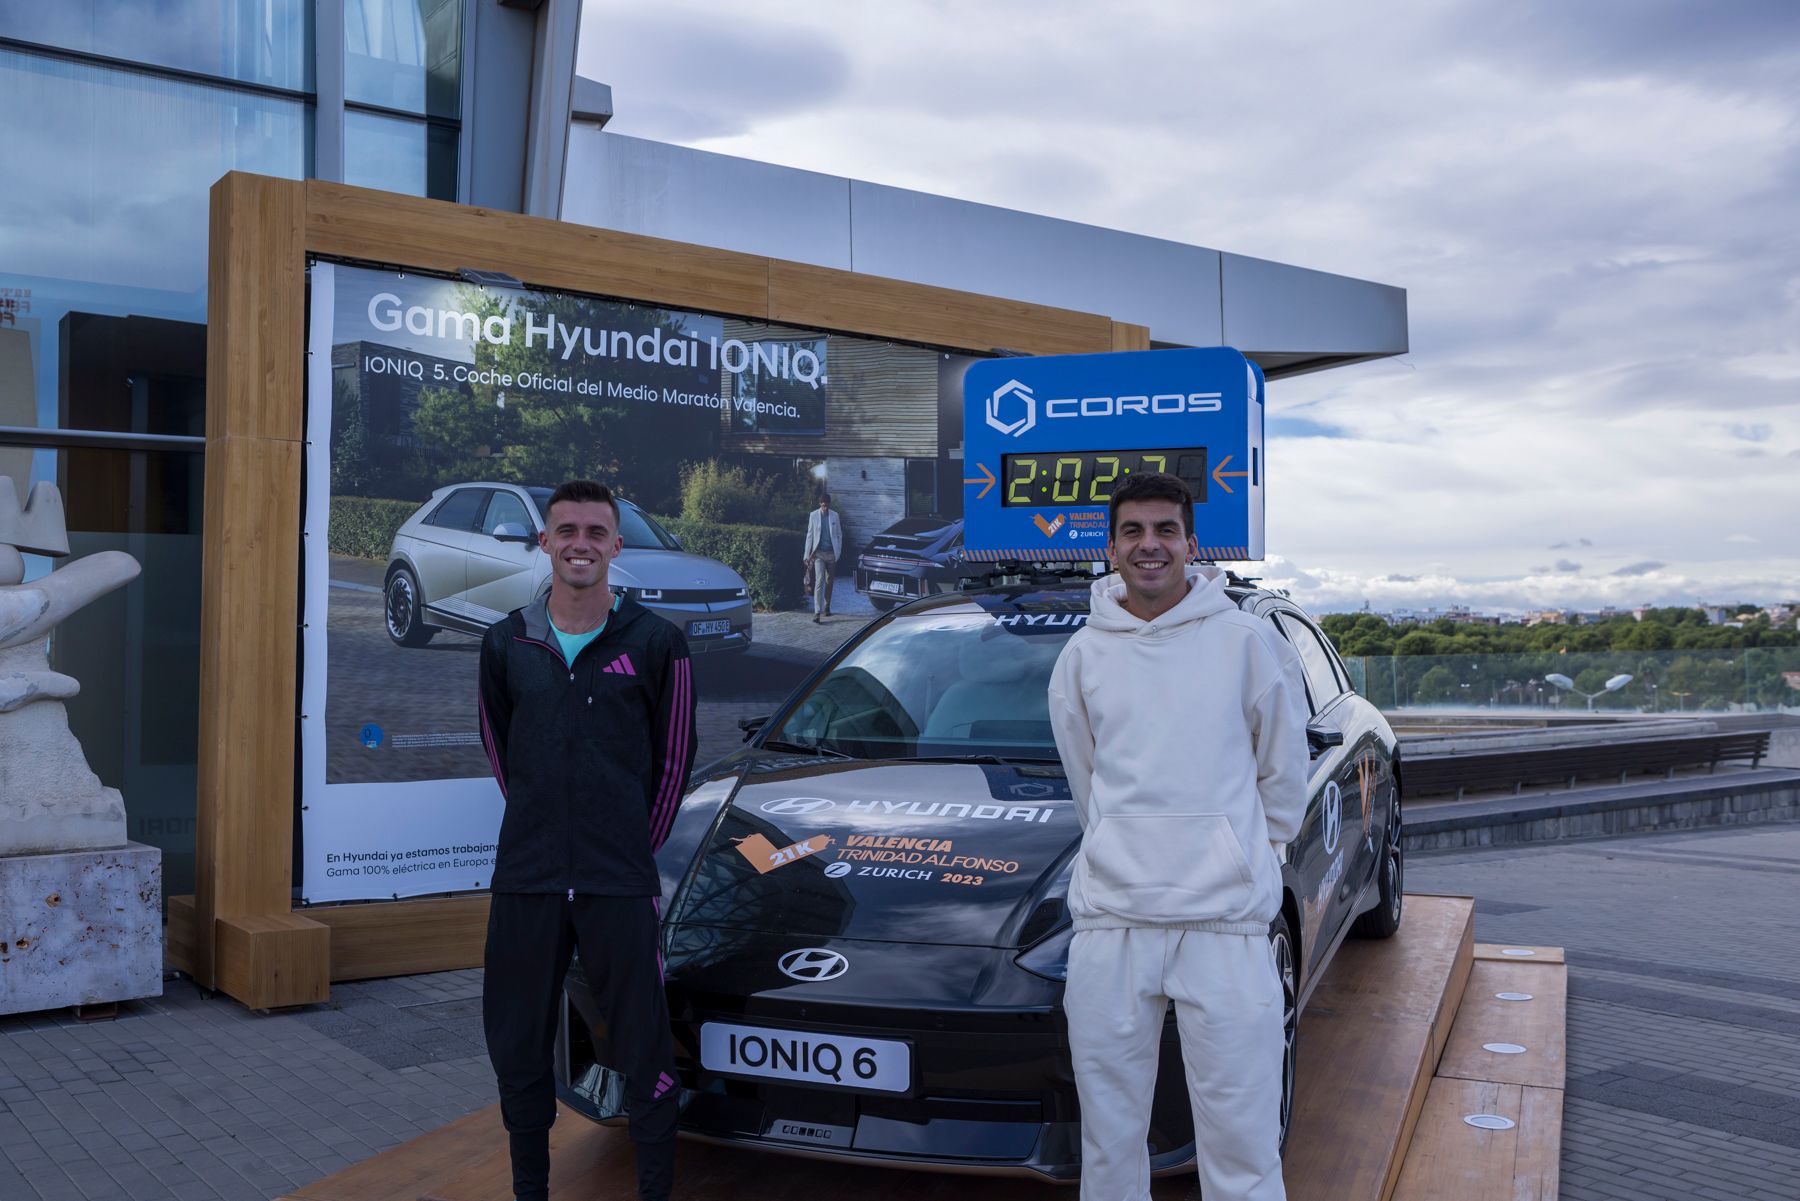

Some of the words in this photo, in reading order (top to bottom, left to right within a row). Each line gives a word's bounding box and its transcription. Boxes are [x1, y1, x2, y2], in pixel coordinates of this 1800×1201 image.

[367, 292, 511, 346] Gama
[525, 311, 698, 368] Hyundai
[709, 335, 828, 390] IONIQ.
[365, 355, 424, 381] IONIQ
[433, 363, 450, 381] 5.
[453, 365, 513, 387] Coche
[517, 371, 572, 393] Oficial
[577, 379, 602, 396] del
[607, 381, 658, 402] Medio
[662, 387, 730, 410] Maratón
[733, 396, 801, 419] Valencia.
[1046, 392, 1222, 418] COROS
[1069, 512, 1105, 521] VALENCIA
[846, 799, 1054, 824] HYUNDAI
[769, 842, 814, 867] 21K
[846, 834, 953, 852] VALENCIA
[326, 853, 340, 863] En
[343, 850, 388, 864] Hyundai
[390, 852, 402, 863] ya
[405, 848, 450, 859] estamos
[326, 866, 360, 877] Gama
[363, 864, 390, 876] 100%
[392, 862, 436, 875] eléctrica
[438, 860, 451, 869] en
[453, 857, 489, 869] Europa
[836, 848, 924, 864] TRINIDAD
[921, 853, 1019, 874] ALFONSO
[858, 866, 933, 881] ZURICH
[940, 873, 984, 887] 2023
[730, 1033, 842, 1082] IONIQ
[852, 1047, 878, 1079] 6
